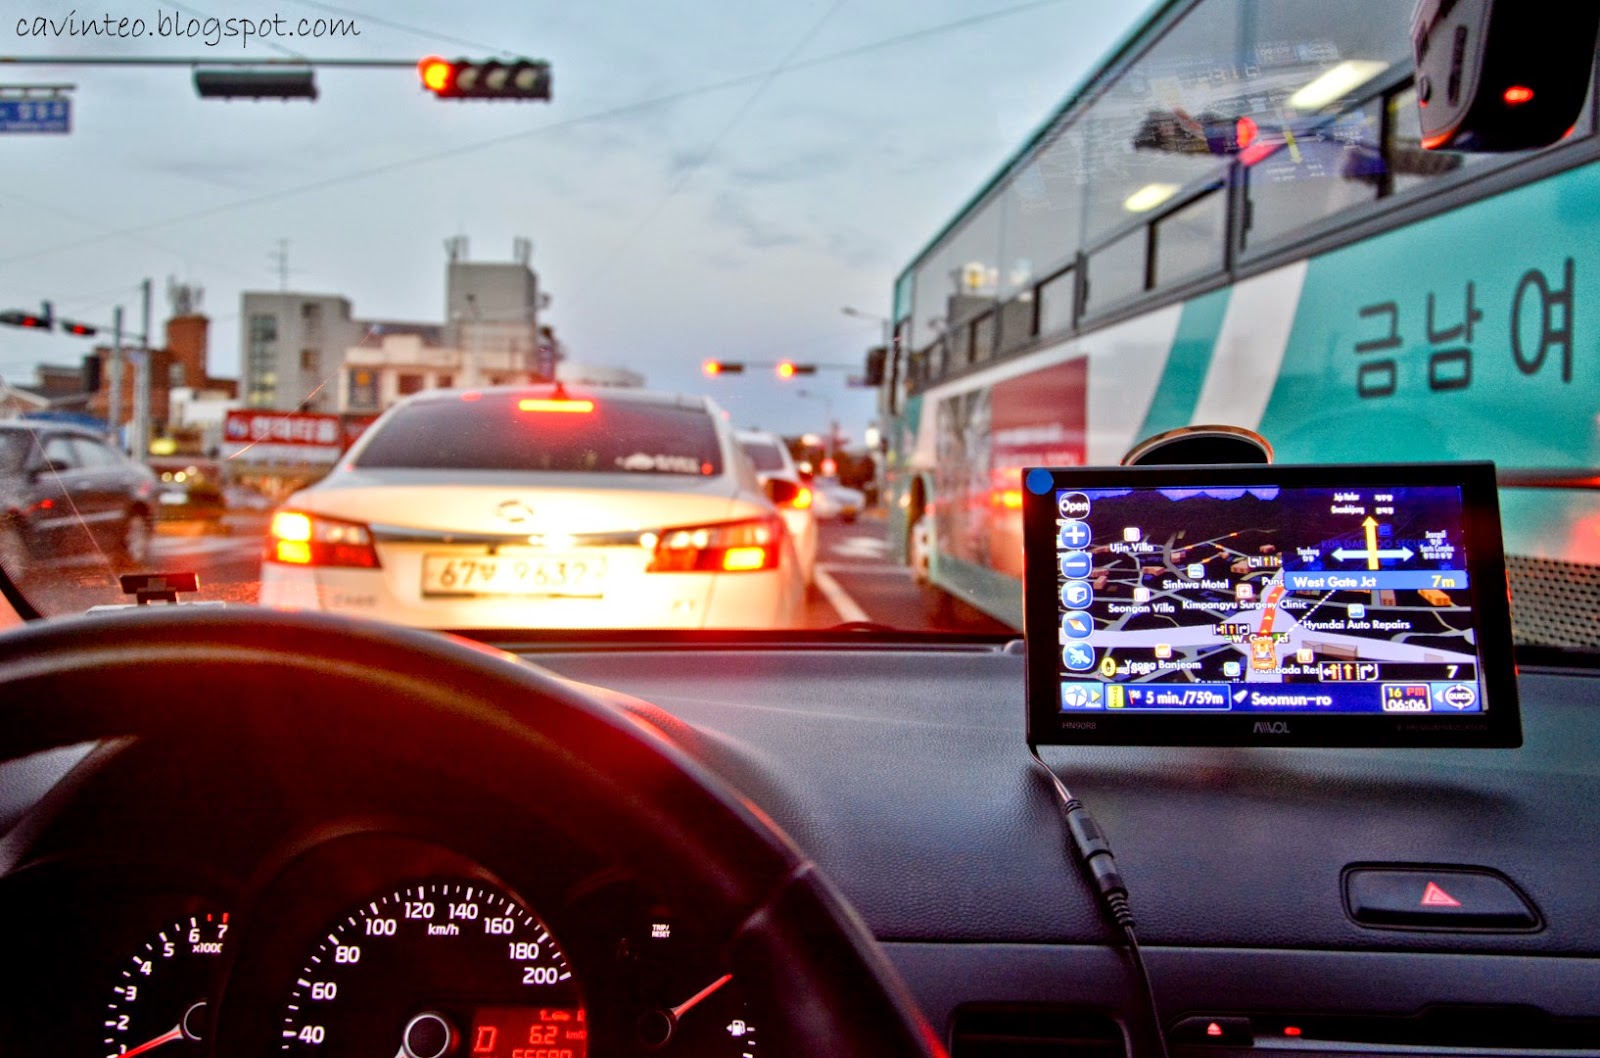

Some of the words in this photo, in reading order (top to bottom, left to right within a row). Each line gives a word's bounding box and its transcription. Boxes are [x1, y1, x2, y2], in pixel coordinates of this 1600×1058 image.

[1061, 500, 1089, 514] Open
[1110, 543, 1130, 553] Ujin
[1132, 543, 1154, 553] Villa
[1162, 580, 1200, 590] Sinhwa
[1201, 579, 1229, 589] Motel
[1293, 576, 1325, 588] West
[1328, 576, 1358, 588] Gate
[1360, 576, 1377, 588] Jct
[1431, 575, 1456, 588] 7m
[1108, 604, 1150, 614] Seongan
[1152, 604, 1175, 613] Villa
[1182, 601, 1238, 611] Kimpangyu
[1240, 601, 1278, 611] Surgery
[1279, 600, 1307, 610] Clinic
[1303, 620, 1345, 631] Hyundai
[1347, 620, 1370, 630] Auto
[1373, 620, 1411, 631] Repairs
[1158, 660, 1202, 671] Banjeom
[1447, 665, 1459, 679] 7
[1146, 691, 1155, 705] 5
[1388, 687, 1402, 698] 16
[1406, 687, 1425, 697] PM
[1388, 699, 1426, 710] 06:06
[404, 901, 435, 919] 120
[449, 903, 479, 920] 140
[217, 924, 228, 939] 7
[365, 918, 397, 936] 100
[427, 923, 460, 936] km/h
[484, 917, 514, 935] 160
[188, 928, 200, 943] 6
[163, 943, 175, 957] 5
[335, 946, 360, 963] 80
[508, 942, 539, 960] 180
[140, 960, 152, 976] 4
[522, 967, 558, 985] 200
[125, 986, 137, 1001] 3
[311, 982, 337, 1000] 60
[117, 1015, 130, 1031] 2
[299, 1026, 325, 1044] 40
